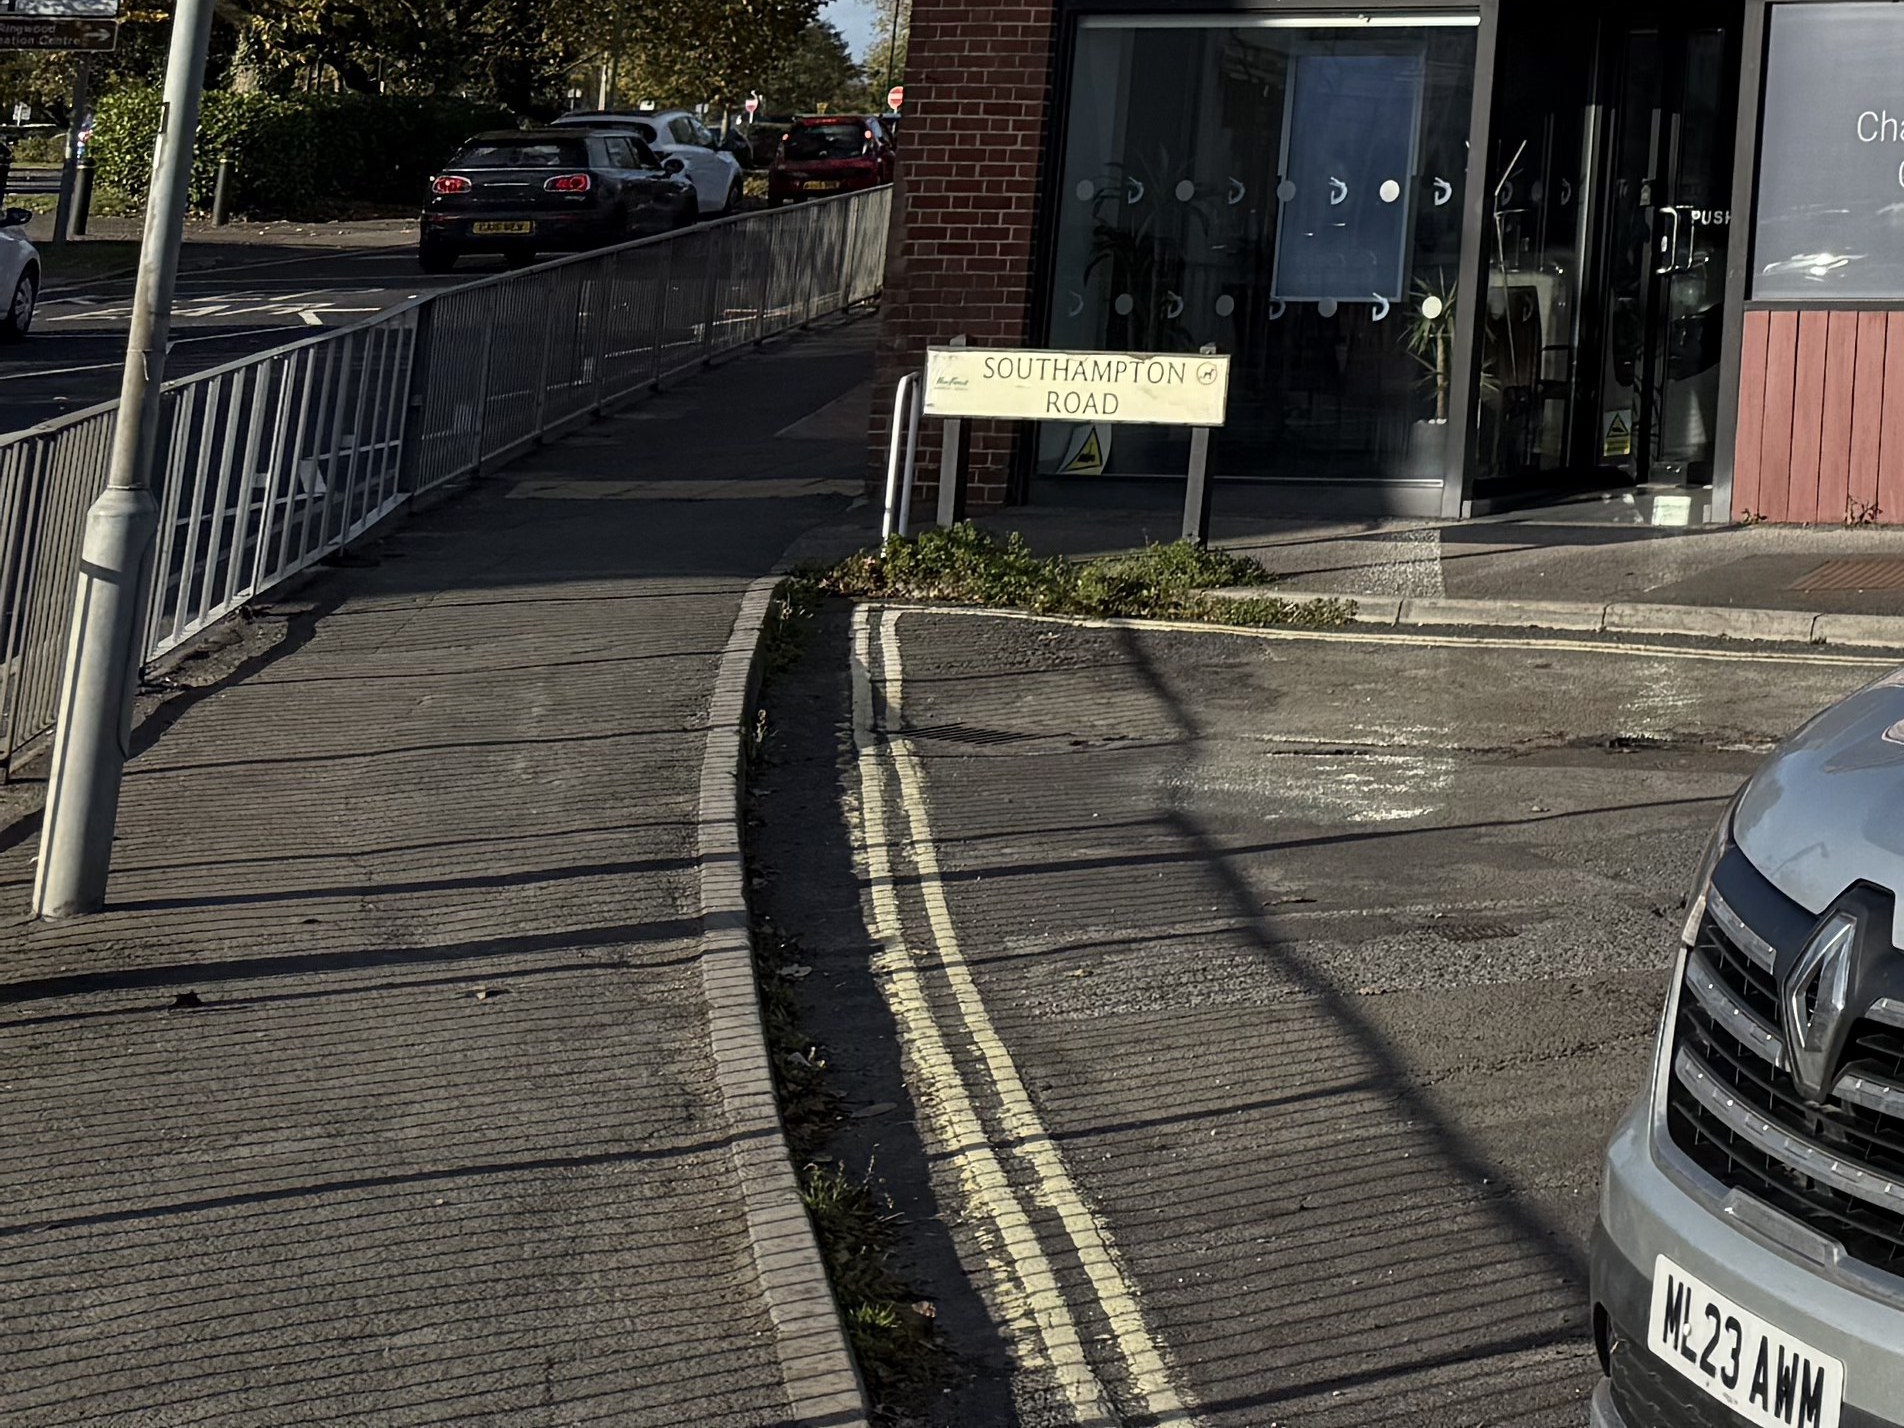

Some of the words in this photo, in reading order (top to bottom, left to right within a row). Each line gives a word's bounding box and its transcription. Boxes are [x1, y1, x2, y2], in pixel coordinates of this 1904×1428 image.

[983, 357, 1186, 384] SOUTHAMPTON
[1046, 391, 1119, 414] ROAD
[1662, 1274, 1743, 1391] ML23
[1749, 1334, 1825, 1428] AWM
